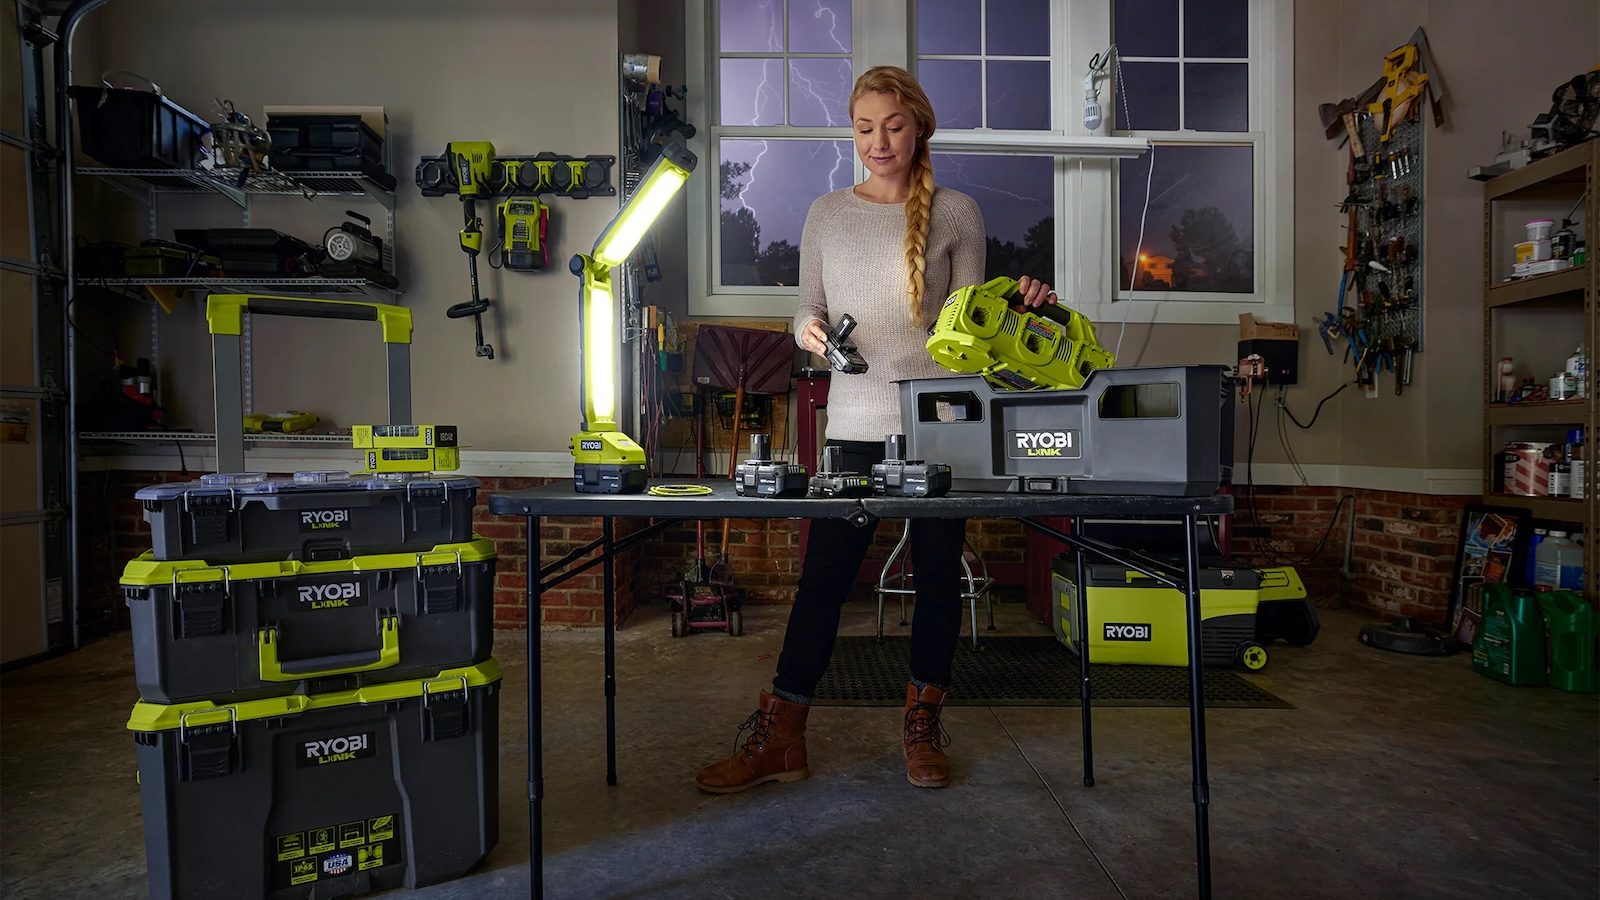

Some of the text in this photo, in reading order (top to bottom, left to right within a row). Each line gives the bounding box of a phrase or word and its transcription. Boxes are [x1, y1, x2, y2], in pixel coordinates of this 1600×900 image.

[582, 442, 602, 450] RYOBI
[1015, 432, 1073, 448] RYOBI
[301, 510, 349, 524] RYOBI
[297, 581, 361, 602] RYOBI
[1105, 625, 1149, 639] RYOBI
[305, 734, 368, 758] RYOBI
[327, 860, 349, 870] USA
